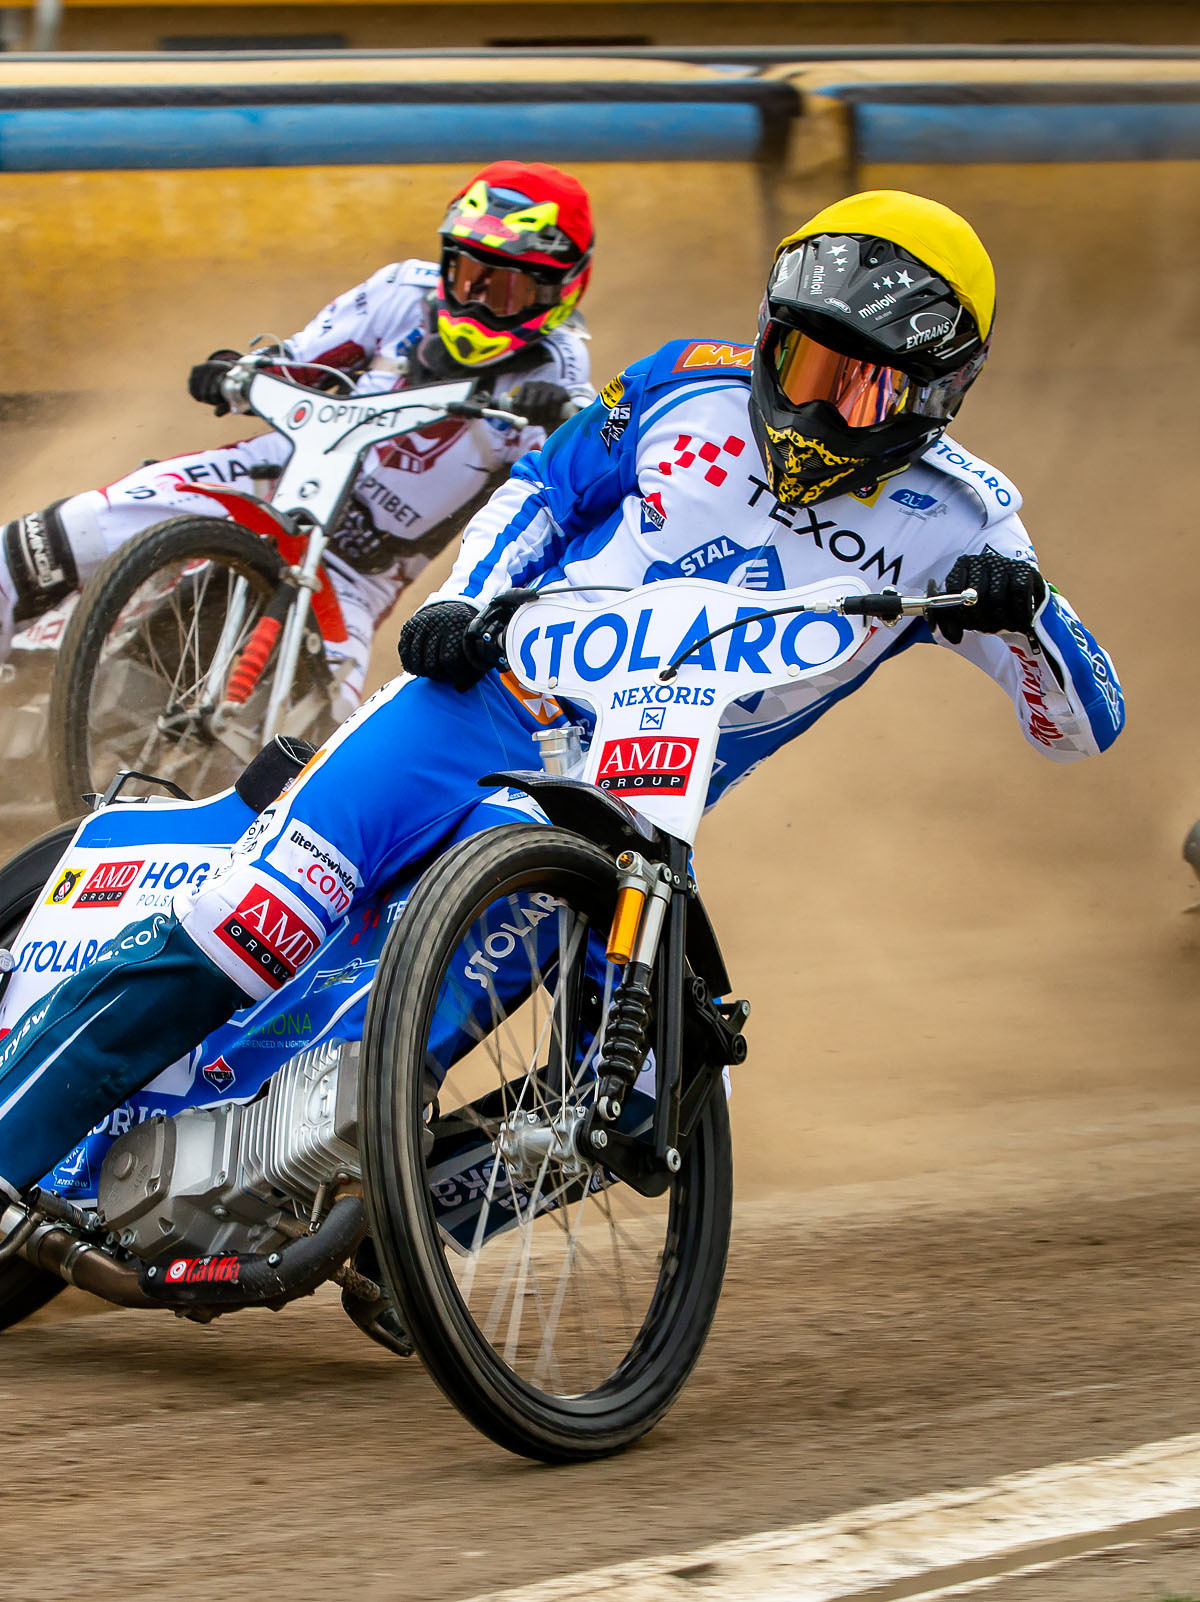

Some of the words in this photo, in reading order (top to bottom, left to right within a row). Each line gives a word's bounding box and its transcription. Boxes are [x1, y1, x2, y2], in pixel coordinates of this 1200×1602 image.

[905, 321, 951, 350] EXTRANS
[317, 405, 402, 428] OPTIBET
[931, 439, 1012, 507] STOLARO
[359, 476, 422, 528] PTIBET
[748, 474, 904, 585] TEXOM
[680, 536, 735, 577] STAL
[519, 605, 855, 682] STOLARO
[610, 685, 716, 709] NEXORIS
[600, 740, 693, 774] AMD
[601, 777, 681, 789] GROUP
[80, 892, 124, 902] GROUP
[85, 864, 139, 889] AMD
[297, 864, 350, 914] .com
[230, 924, 291, 980] GROUP
[238, 898, 314, 968] AMD
